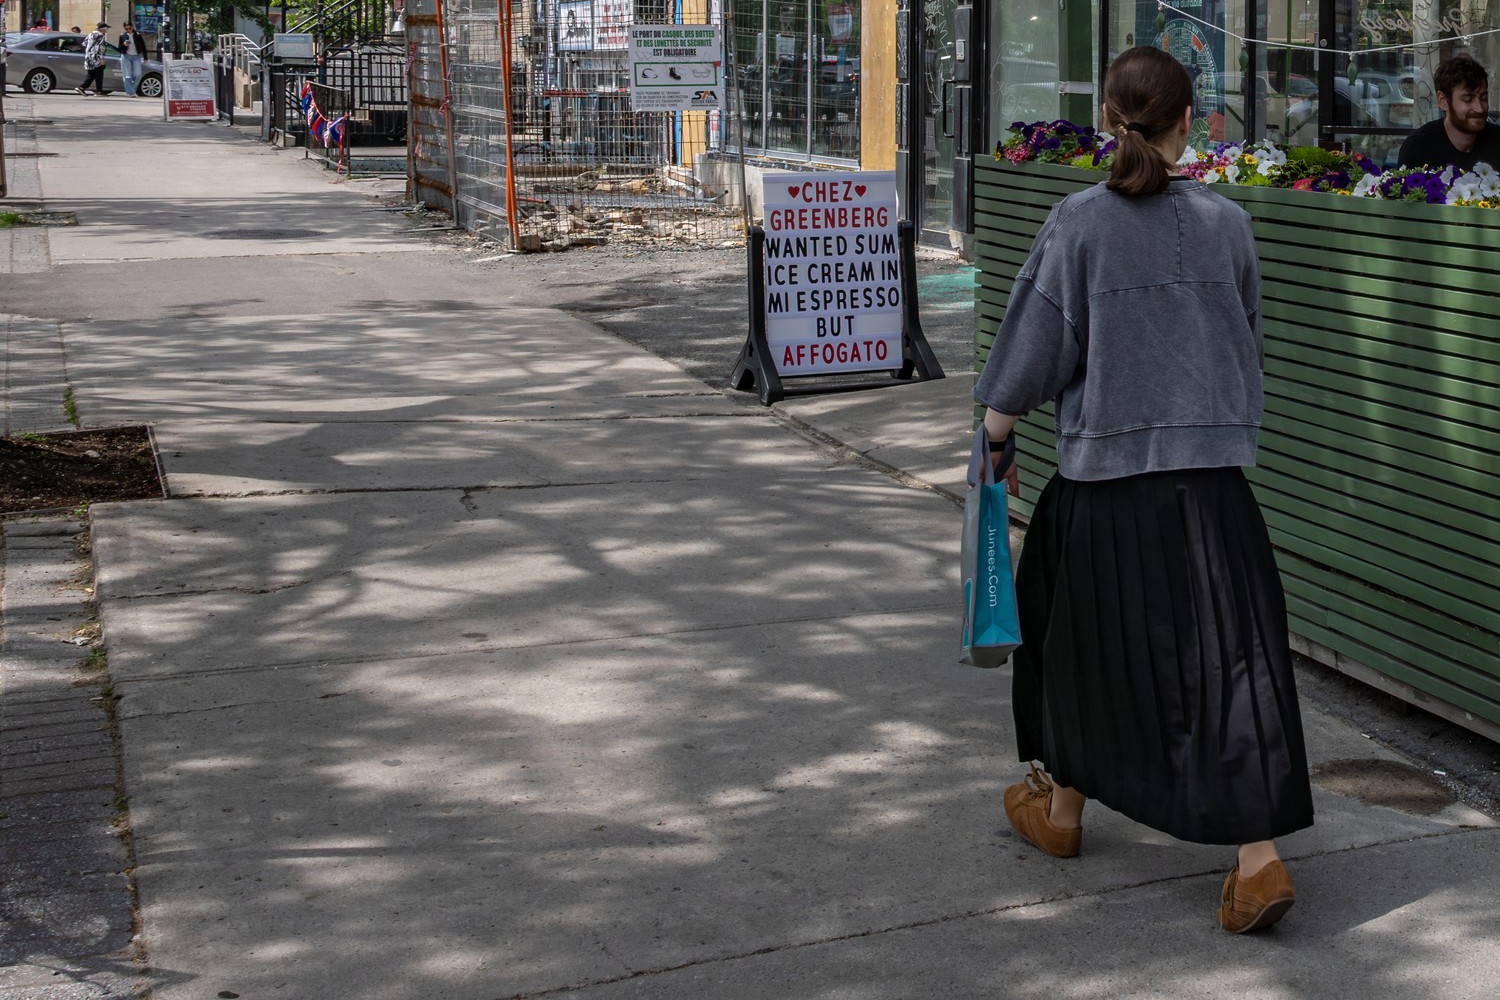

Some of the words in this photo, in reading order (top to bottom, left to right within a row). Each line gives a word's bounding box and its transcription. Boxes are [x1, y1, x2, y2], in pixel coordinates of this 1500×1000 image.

[1170, 0, 1180, 9] vie
[632, 30, 638, 38] LE
[639, 30, 653, 38] PORT
[653, 30, 661, 38] DU
[685, 30, 695, 38] DES
[695, 30, 715, 38] BOTTES
[654, 39, 679, 47] LUNETTES
[680, 39, 687, 47] DE
[687, 38, 713, 47] SÉCURITÉ
[653, 48, 663, 57] EST
[663, 48, 697, 56] OBLIGATOIRE
[802, 180, 853, 203] CHEZ
[770, 207, 888, 231] GREENBERG
[766, 236, 848, 258] WANTED
[855, 234, 896, 255] SUM
[768, 264, 798, 286] ICE
[807, 261, 875, 284] CREAM
[882, 260, 898, 281] IN
[768, 292, 789, 313] MI
[797, 287, 900, 312] ESPRESSO
[816, 315, 855, 338] BUT
[783, 339, 888, 367] AFFOGATO
